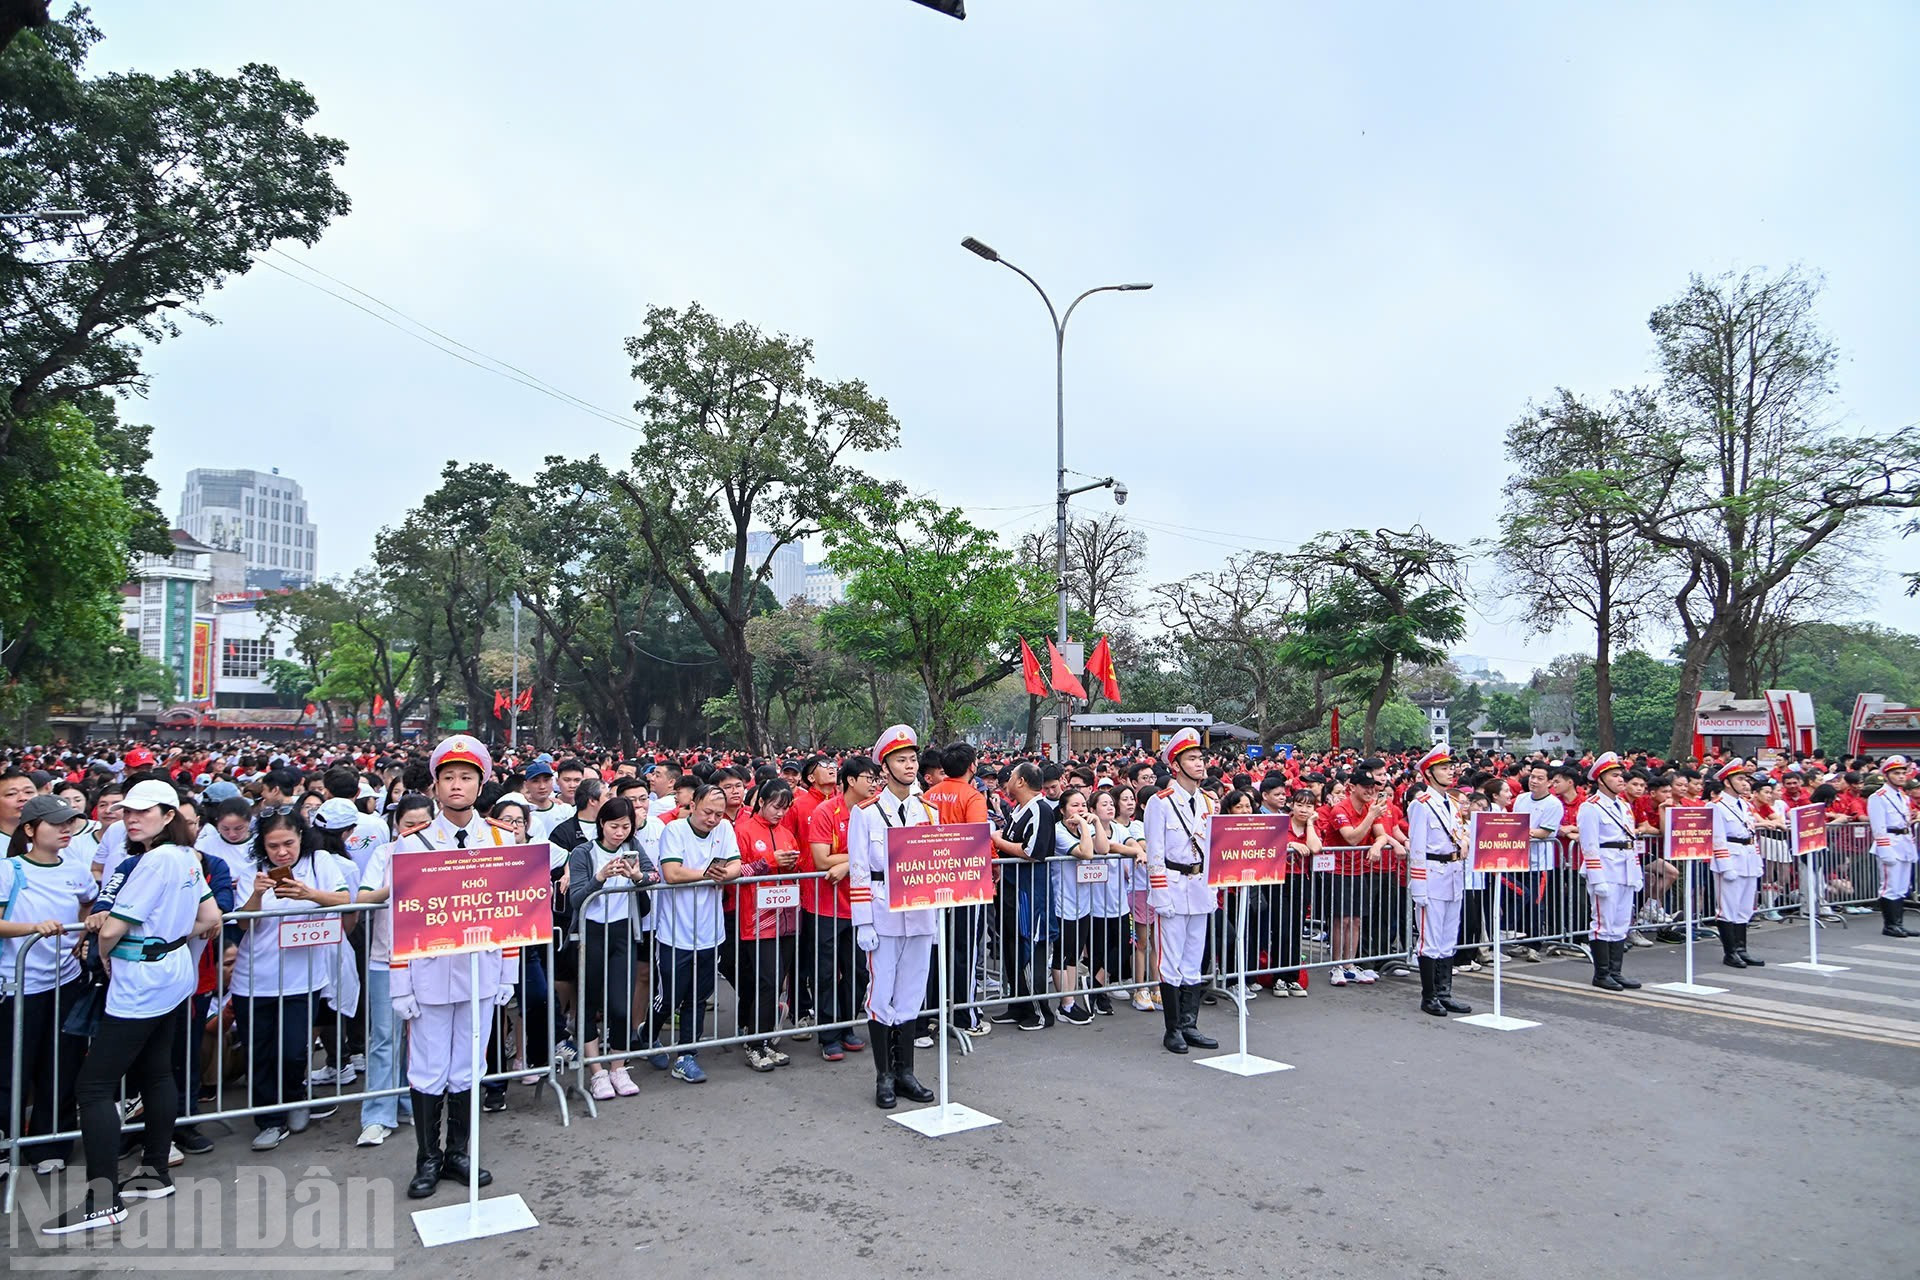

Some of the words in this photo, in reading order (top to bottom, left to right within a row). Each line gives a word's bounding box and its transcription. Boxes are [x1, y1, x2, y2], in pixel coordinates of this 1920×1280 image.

[1241, 848, 1266, 860] NGHỆ
[928, 857, 961, 870] LUYỆN
[963, 856, 986, 868] VIÊN
[462, 877, 487, 890] KHỐI
[902, 874, 923, 887] VẬN
[926, 871, 956, 885] ĐỘNG
[958, 870, 980, 881] VIÊN
[398, 899, 424, 913] HS,
[428, 897, 448, 910] SV
[451, 892, 493, 908] TRỰC
[496, 886, 547, 903] THUỘC
[766, 896, 791, 904] STOP
[426, 911, 448, 927] BỘ
[452, 905, 523, 923] VH,TT&DL
[292, 930, 330, 942] STOP
[83, 1206, 118, 1220] TOMMY
